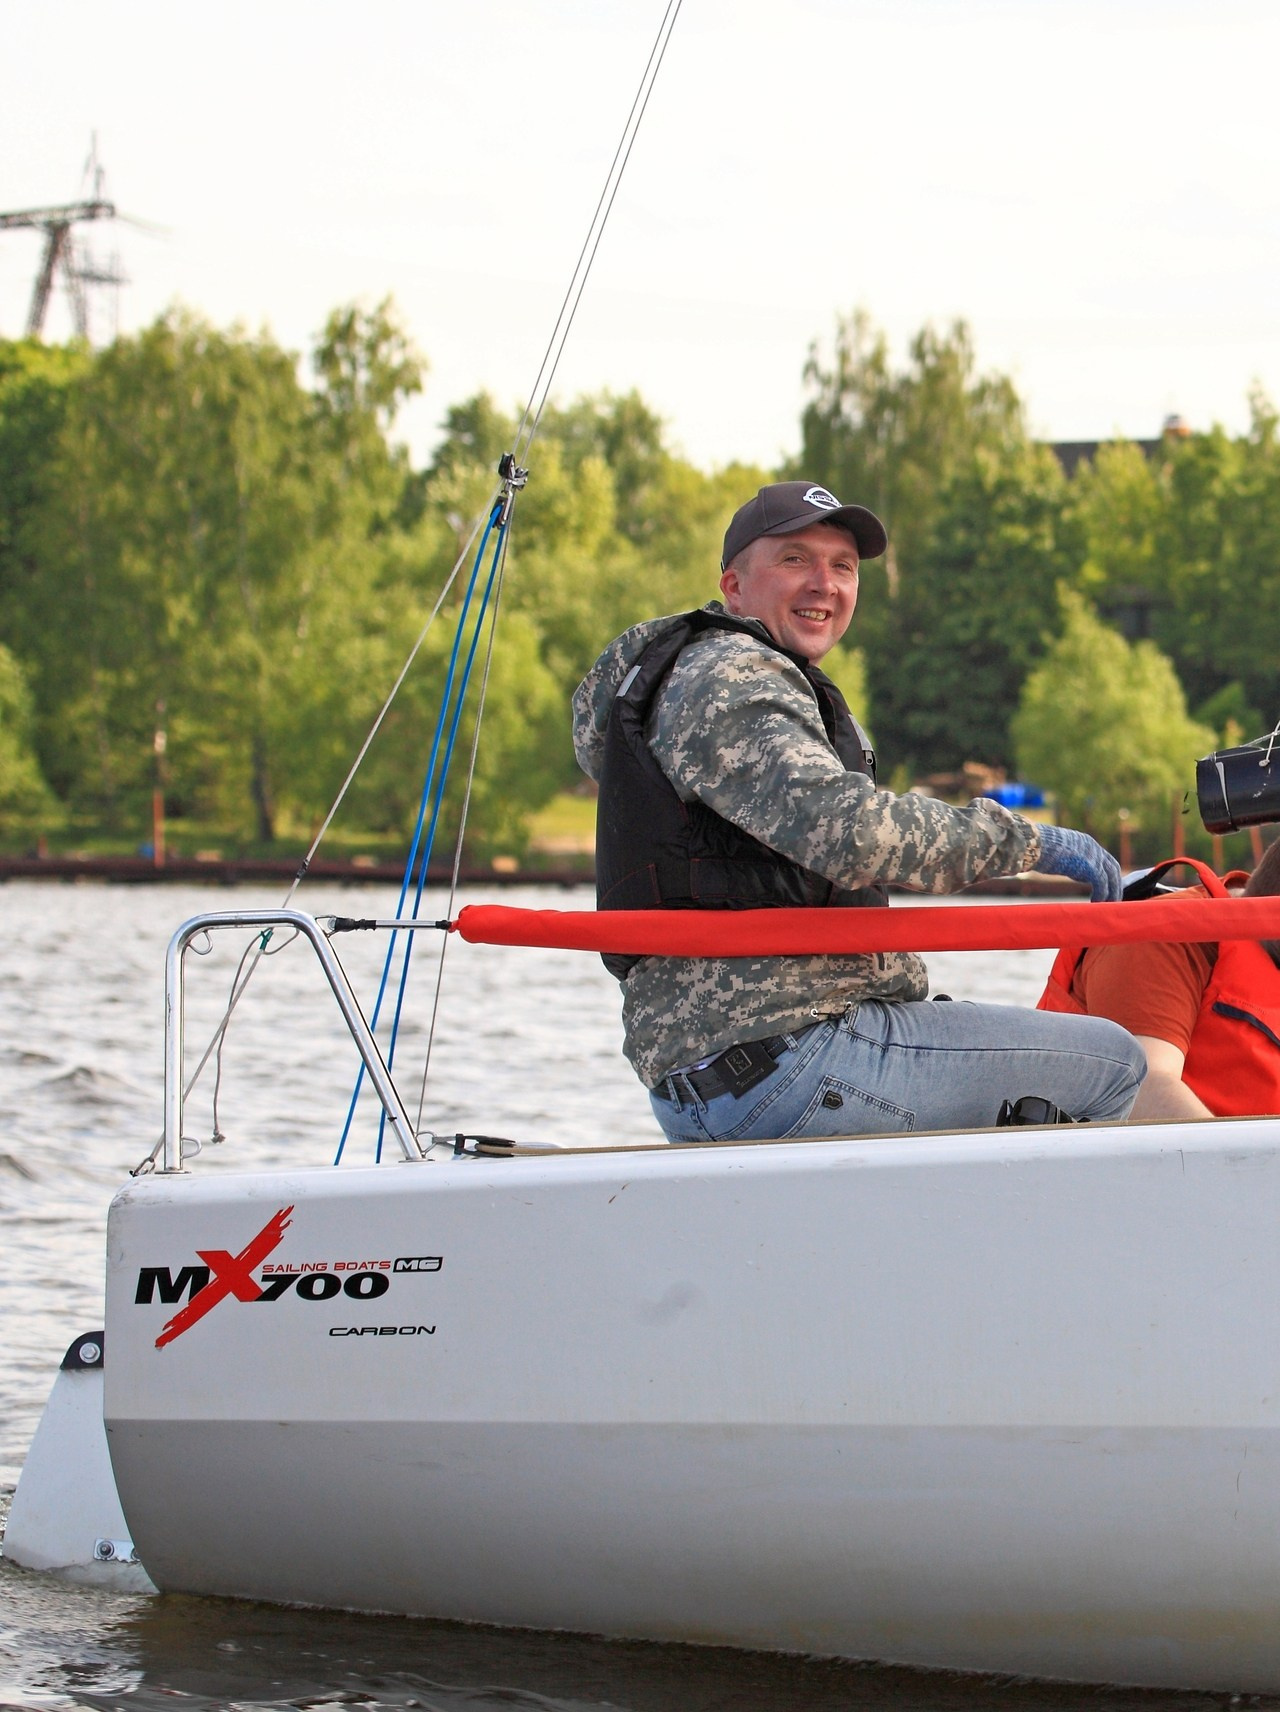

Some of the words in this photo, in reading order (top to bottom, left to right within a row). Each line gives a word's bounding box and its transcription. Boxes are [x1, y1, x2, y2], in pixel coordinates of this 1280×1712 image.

[262, 1262, 328, 1273] SAILING
[333, 1260, 391, 1271] BOATS
[329, 1325, 436, 1337] CARBON
